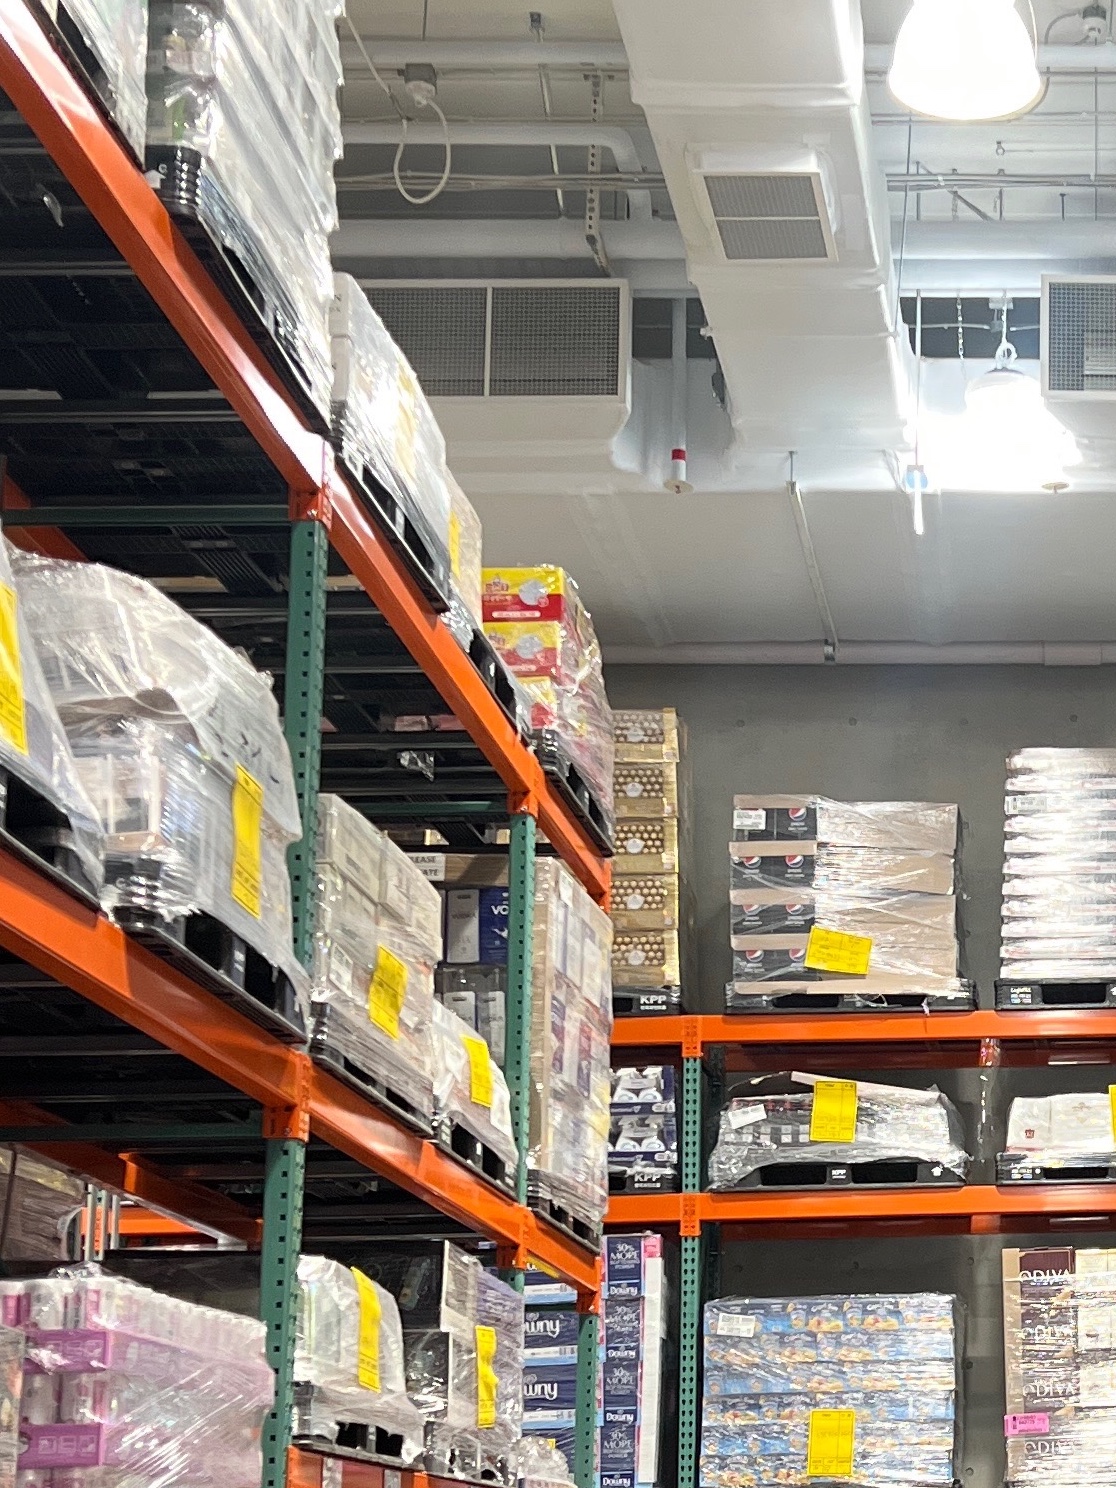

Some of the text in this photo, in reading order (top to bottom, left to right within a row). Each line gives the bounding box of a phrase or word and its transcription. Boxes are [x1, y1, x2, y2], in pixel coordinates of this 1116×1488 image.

[639, 995, 667, 1004] KPP
[634, 1173, 661, 1182] KPP
[615, 1243, 635, 1251] 30%
[610, 1250, 638, 1260] MORE
[1019, 1269, 1072, 1285] ODIVA
[609, 1286, 638, 1296] Downy
[524, 1318, 560, 1338] wny
[607, 1349, 636, 1358] Downy
[612, 1367, 630, 1377] 30%
[606, 1376, 635, 1385] MORE
[523, 1382, 558, 1401] wny
[1023, 1383, 1075, 1397] ODIVA
[606, 1412, 634, 1423] Downy
[604, 1440, 633, 1449] MORE
[602, 1476, 631, 1487] Downy
